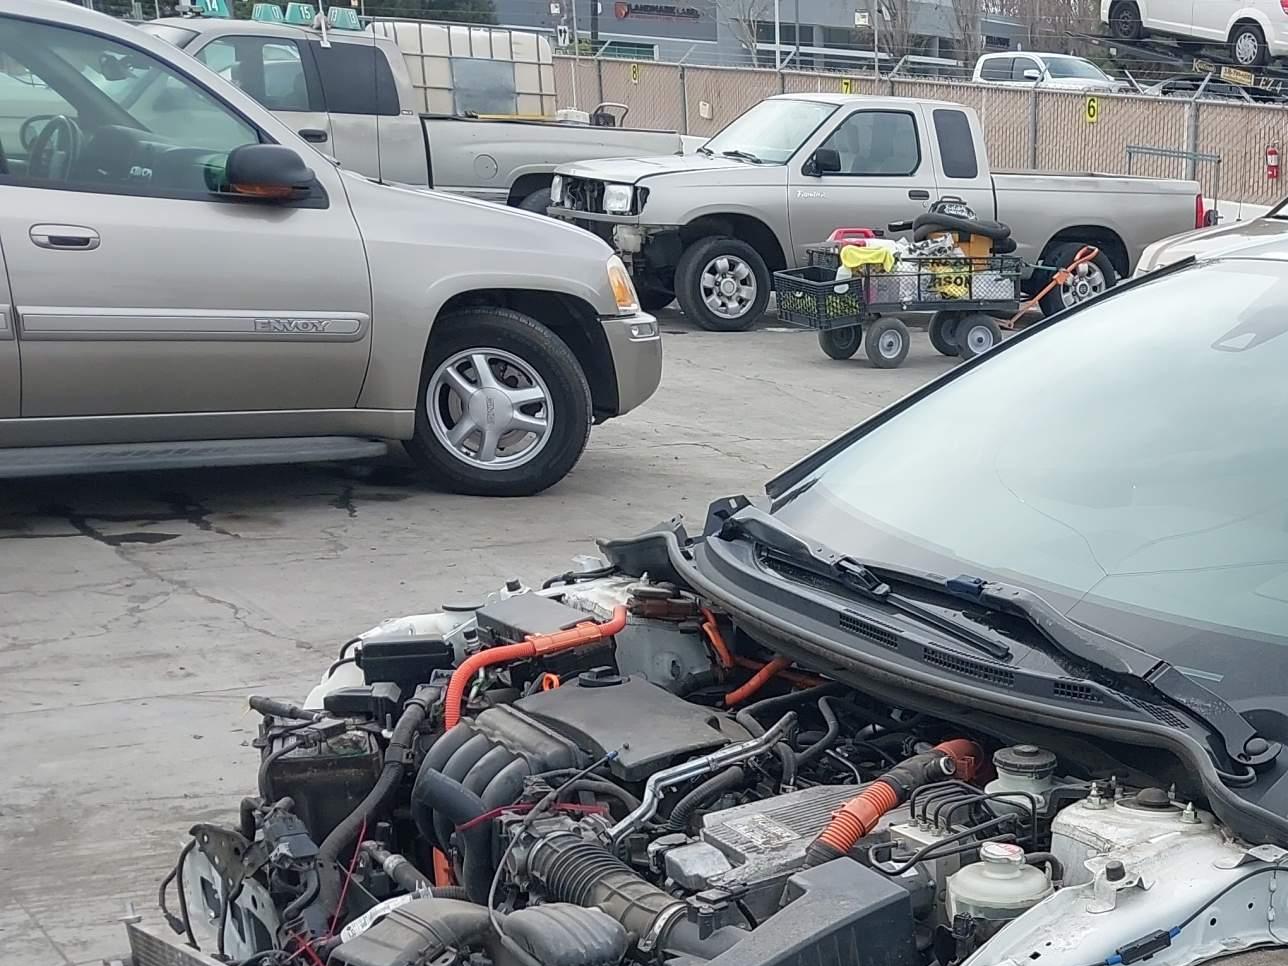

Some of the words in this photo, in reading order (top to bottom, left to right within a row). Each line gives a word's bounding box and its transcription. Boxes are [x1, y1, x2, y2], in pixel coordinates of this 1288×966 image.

[206, 0, 219, 12] 14
[300, 6, 311, 20] 15
[632, 64, 638, 81] 8
[1087, 97, 1096, 118] 6
[254, 318, 330, 332] ENVOY
